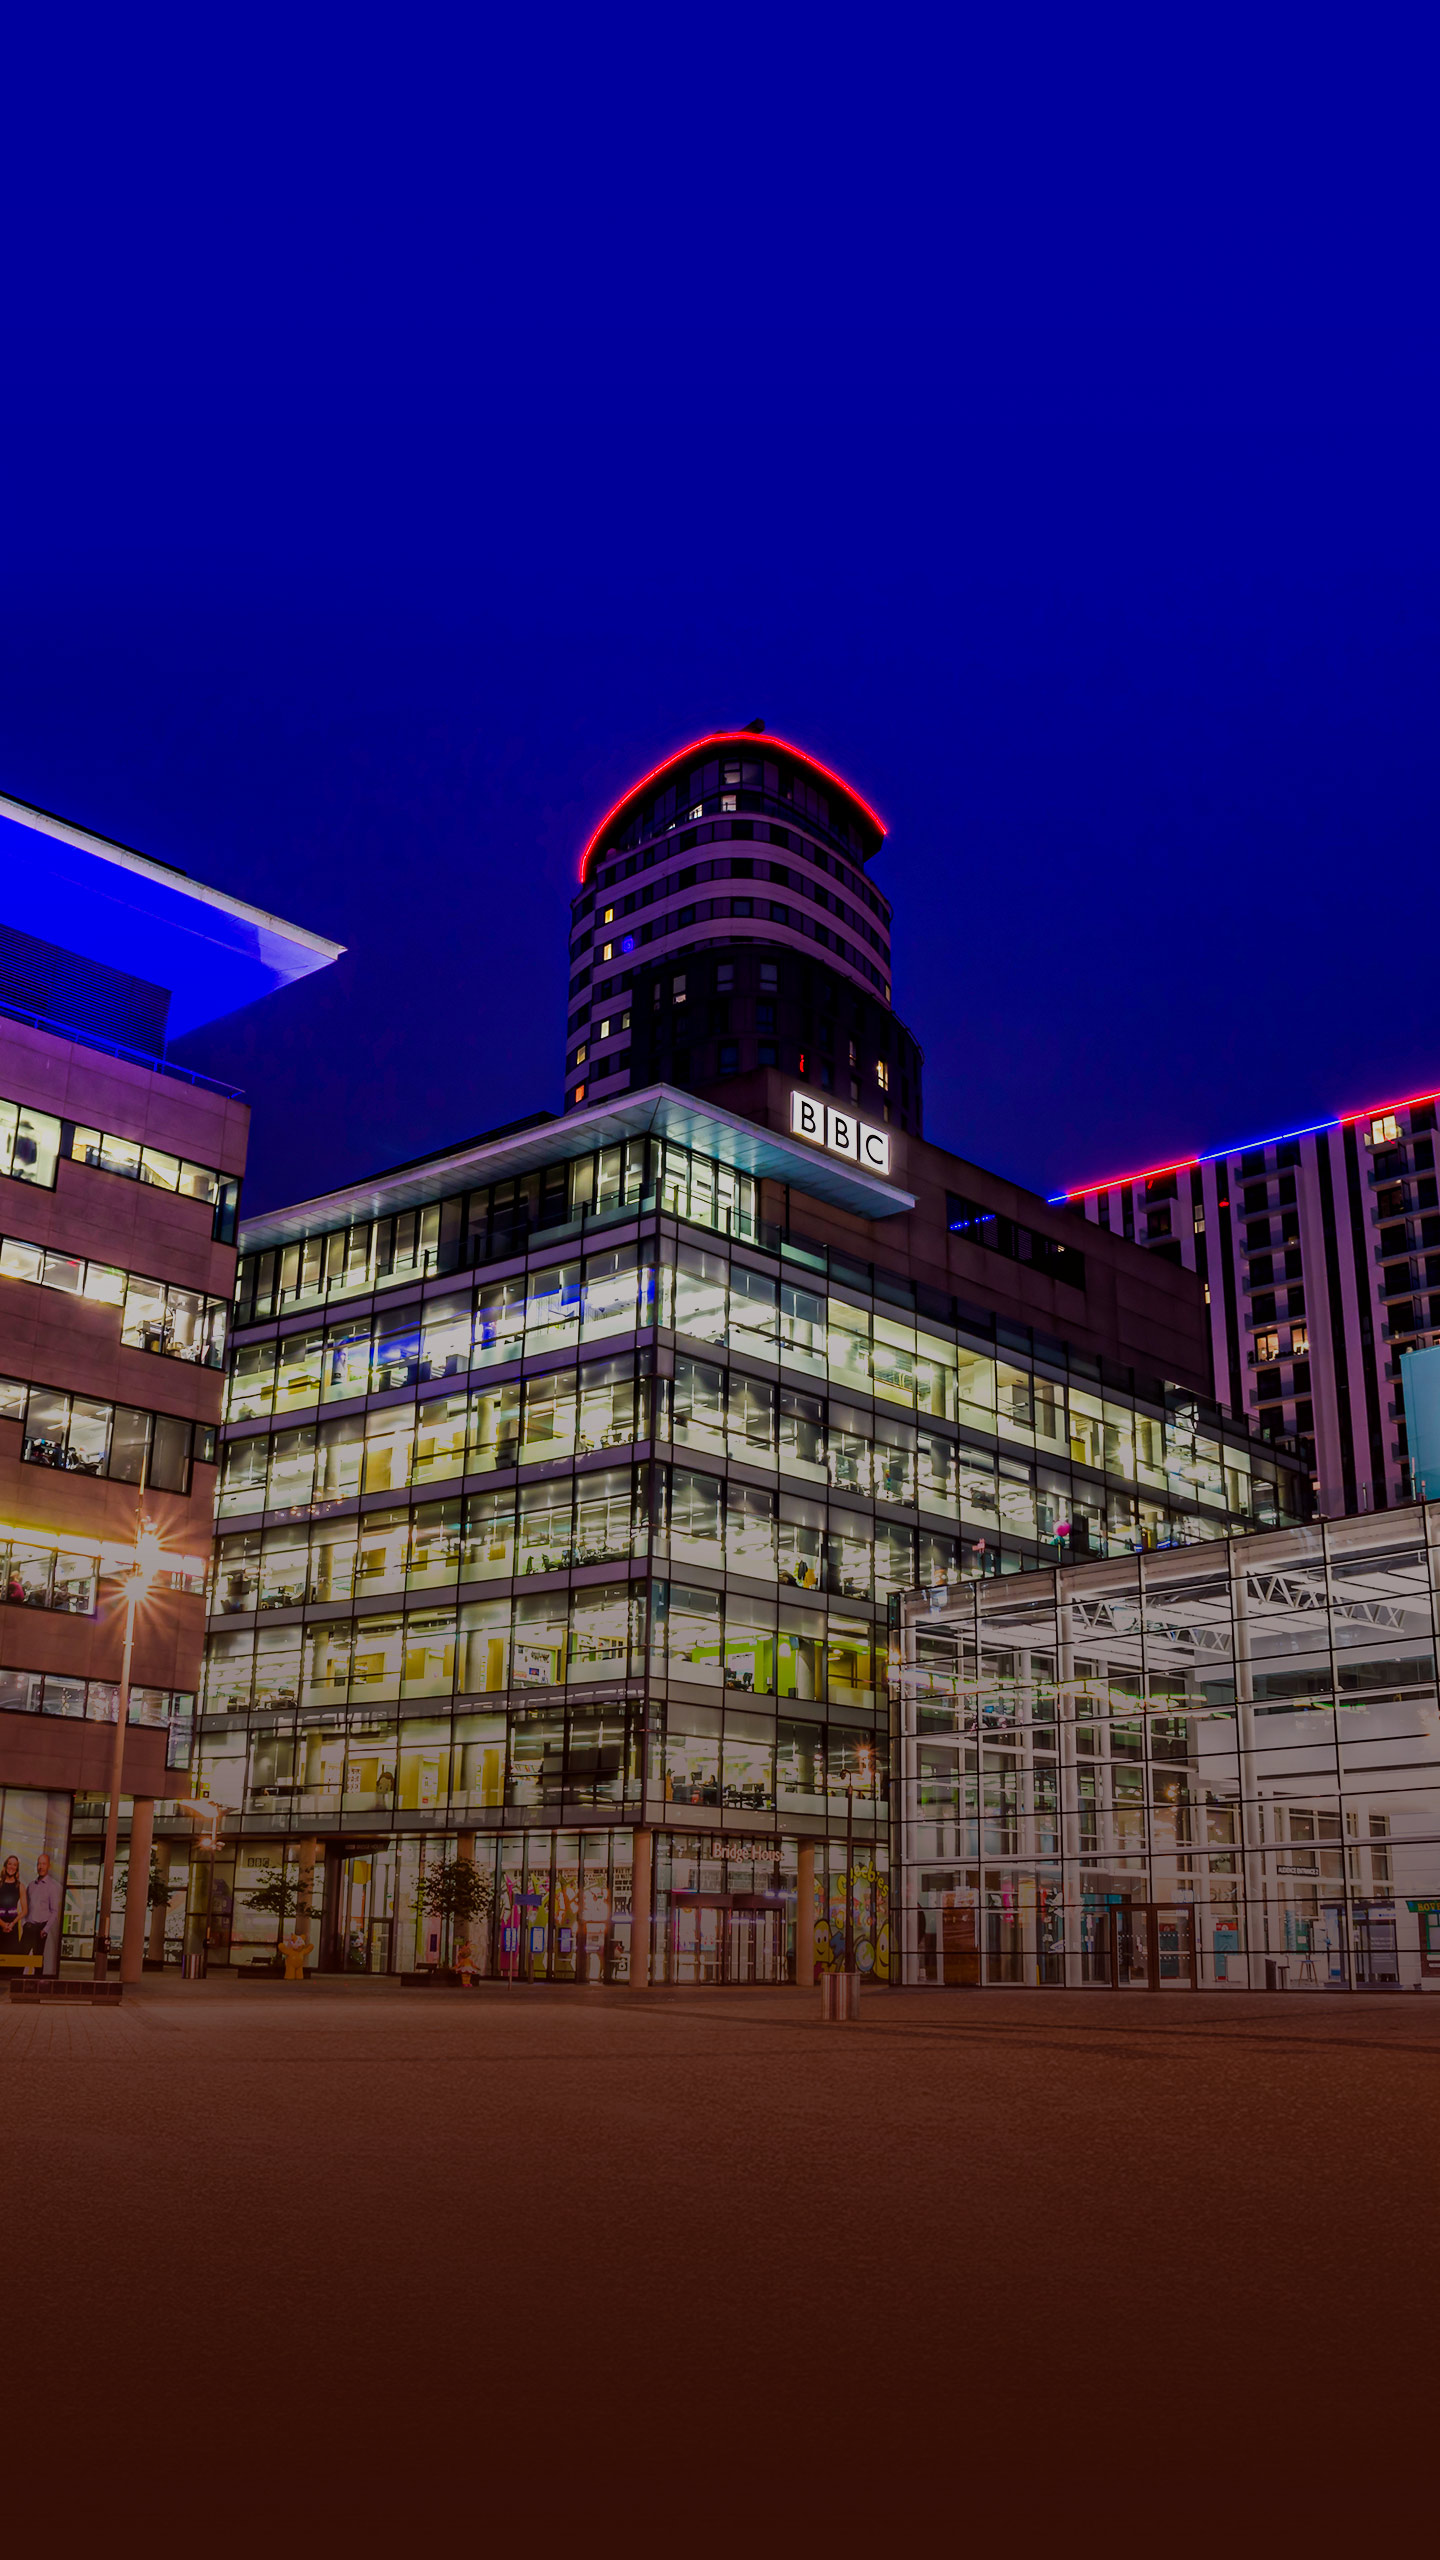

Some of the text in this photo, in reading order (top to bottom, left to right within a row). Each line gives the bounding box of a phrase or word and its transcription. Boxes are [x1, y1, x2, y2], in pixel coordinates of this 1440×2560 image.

[799, 1098, 886, 1167] BBC
[713, 1842, 785, 1864] Bridge House
